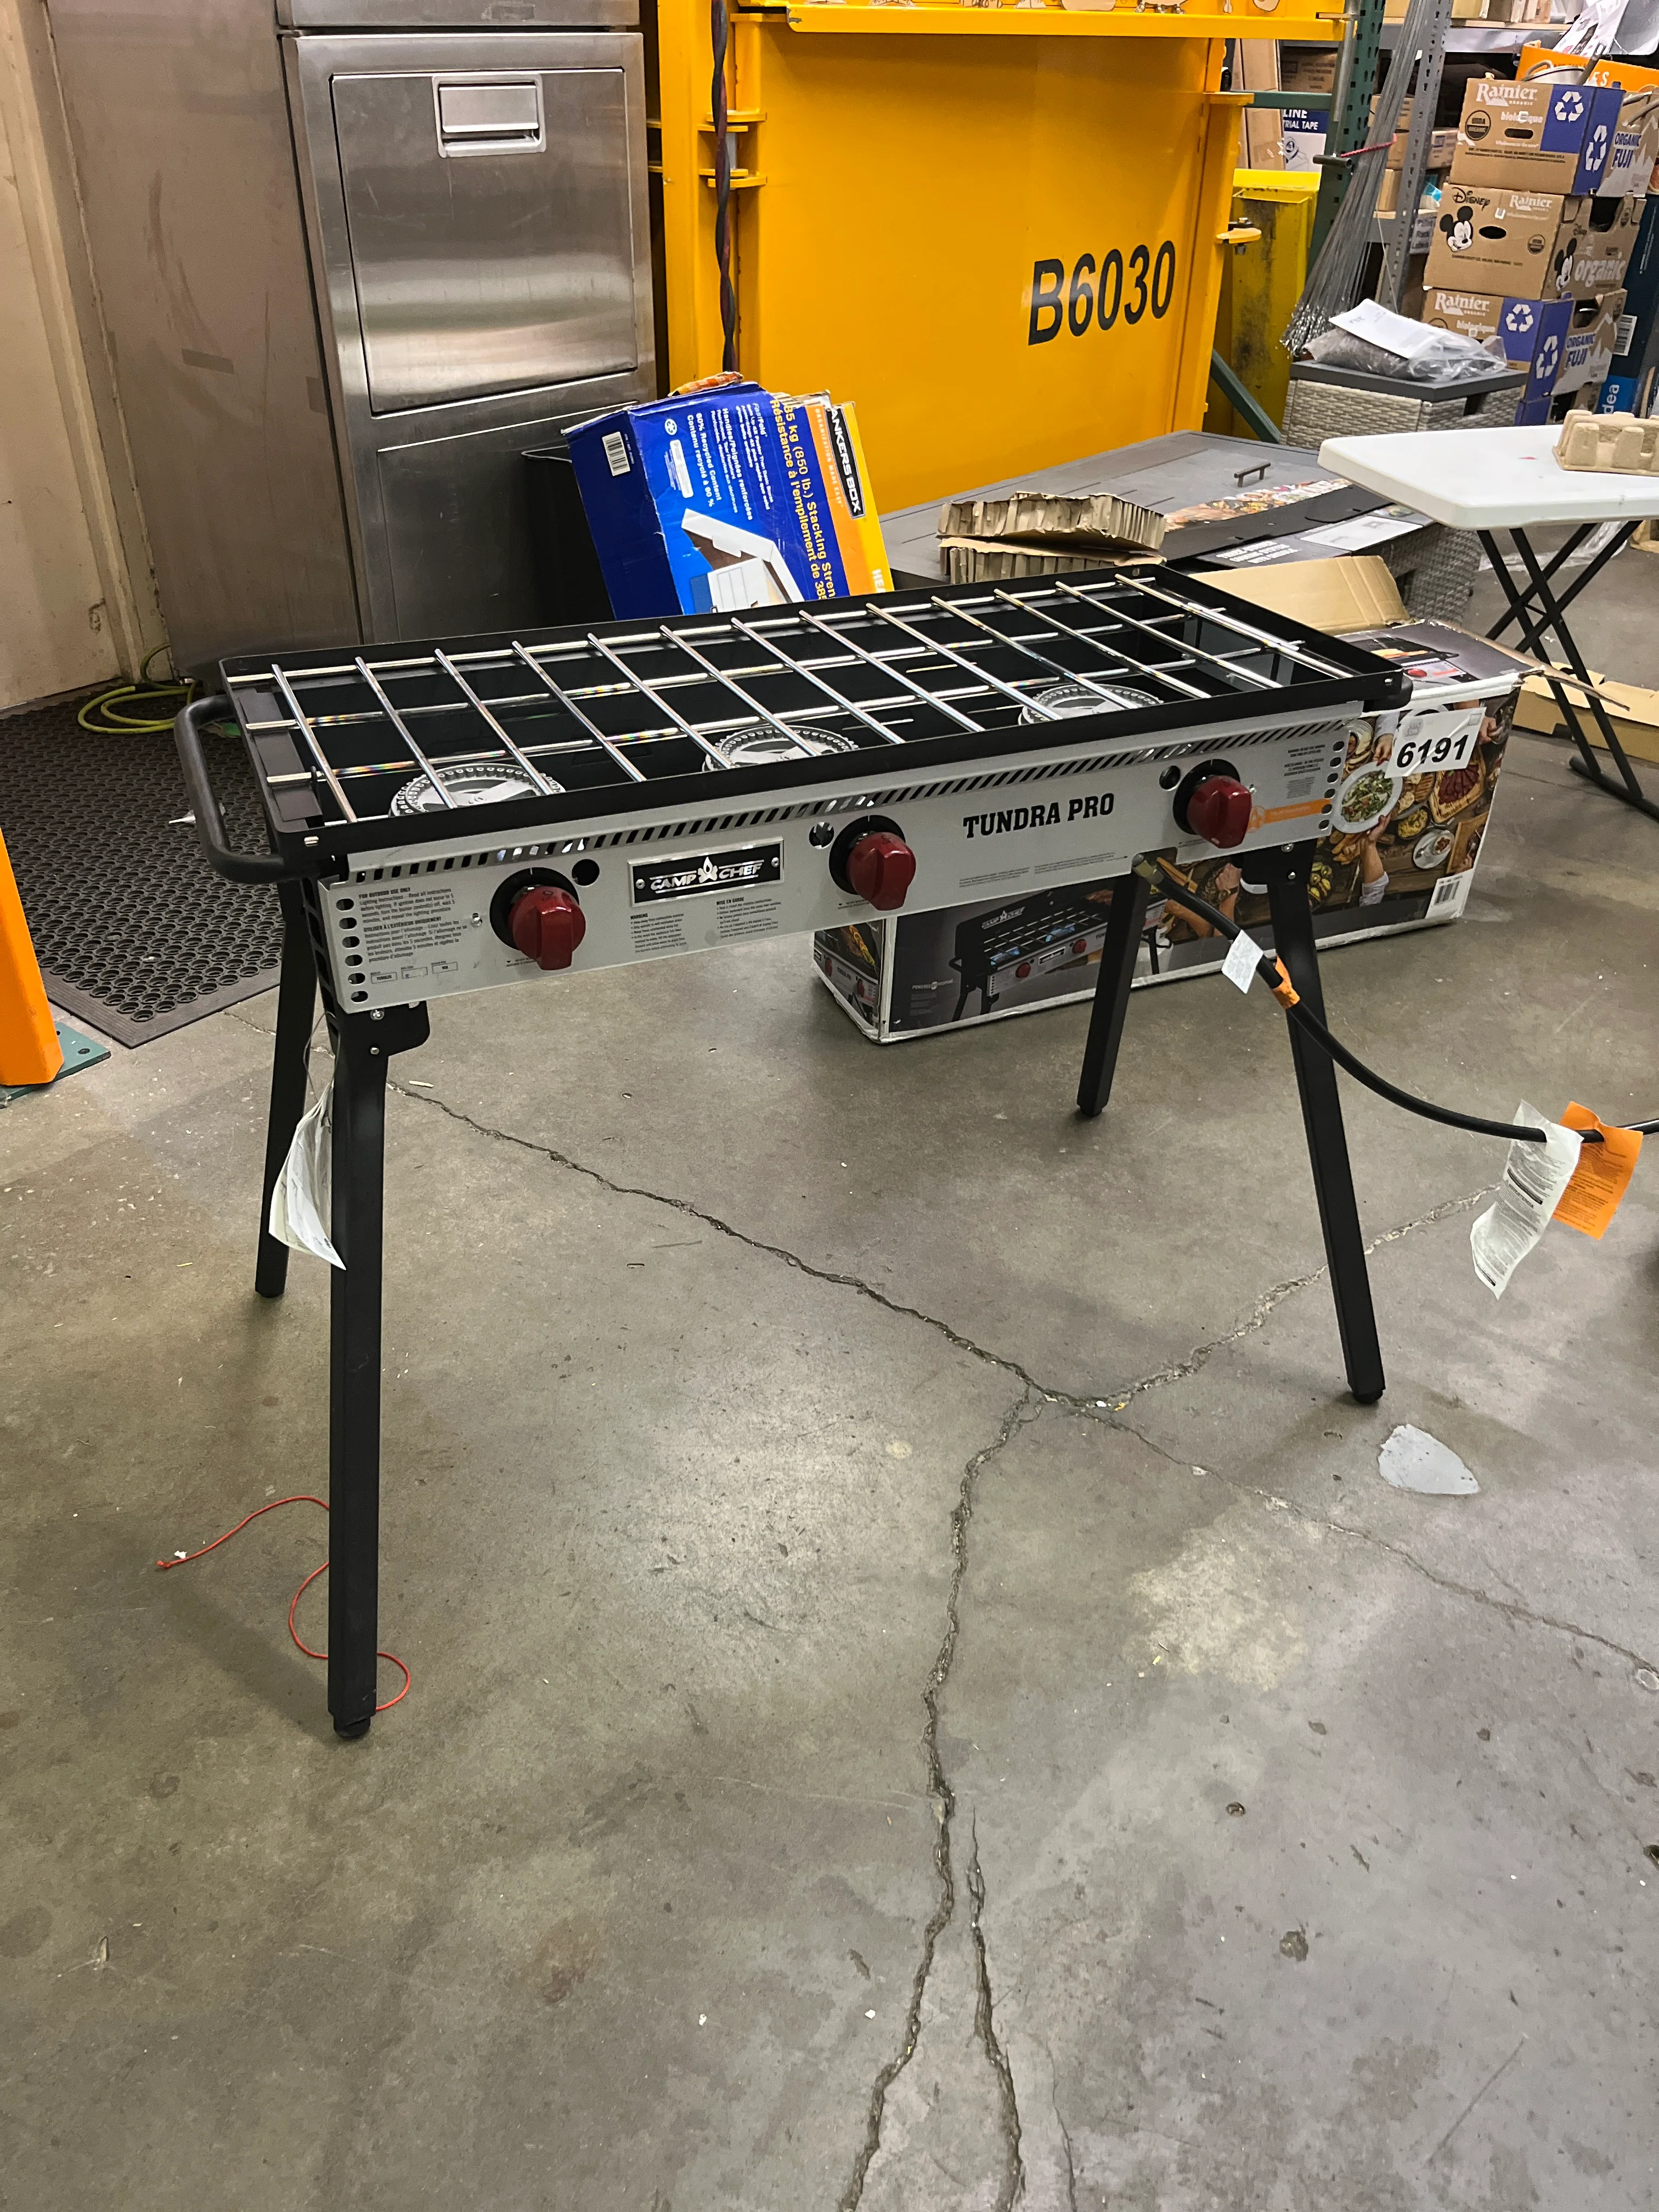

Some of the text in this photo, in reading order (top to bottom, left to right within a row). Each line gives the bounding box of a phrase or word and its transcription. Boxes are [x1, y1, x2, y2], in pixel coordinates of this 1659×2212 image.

[1476, 83, 1538, 104] Rainier
[1302, 121, 1318, 130] TAPE
[1615, 133, 1641, 145] ORGANIC
[1612, 149, 1634, 168] FUJI
[1510, 195, 1553, 208] Rainier
[1575, 252, 1626, 287] organic
[1028, 240, 1175, 346] B6030
[1435, 292, 1490, 314] Rainier
[1566, 334, 1595, 348] ORGANIC
[1566, 348, 1588, 368] FUJI
[687, 415, 699, 448] Contenu
[695, 449, 708, 478] recyclé
[770, 399, 794, 467] Résistance
[789, 425, 799, 443] kg
[815, 409, 832, 462] ORGANIZATION
[829, 465, 837, 484] MADE
[696, 413, 722, 501] 60% Recycled Content
[722, 408, 753, 520] Handles/Poignées renforcées
[792, 446, 808, 475] (850
[788, 470, 798, 479] à
[802, 478, 813, 498] lb.)
[847, 477, 861, 513] BOX
[791, 481, 817, 562] l'empilement
[807, 501, 827, 560] Stacking
[811, 563, 820, 579] de
[822, 562, 836, 597] Stren
[1397, 735, 1469, 768] 6191
[963, 793, 1114, 839] TUNDRA PRO
[651, 862, 763, 890] CAMP CHEF
